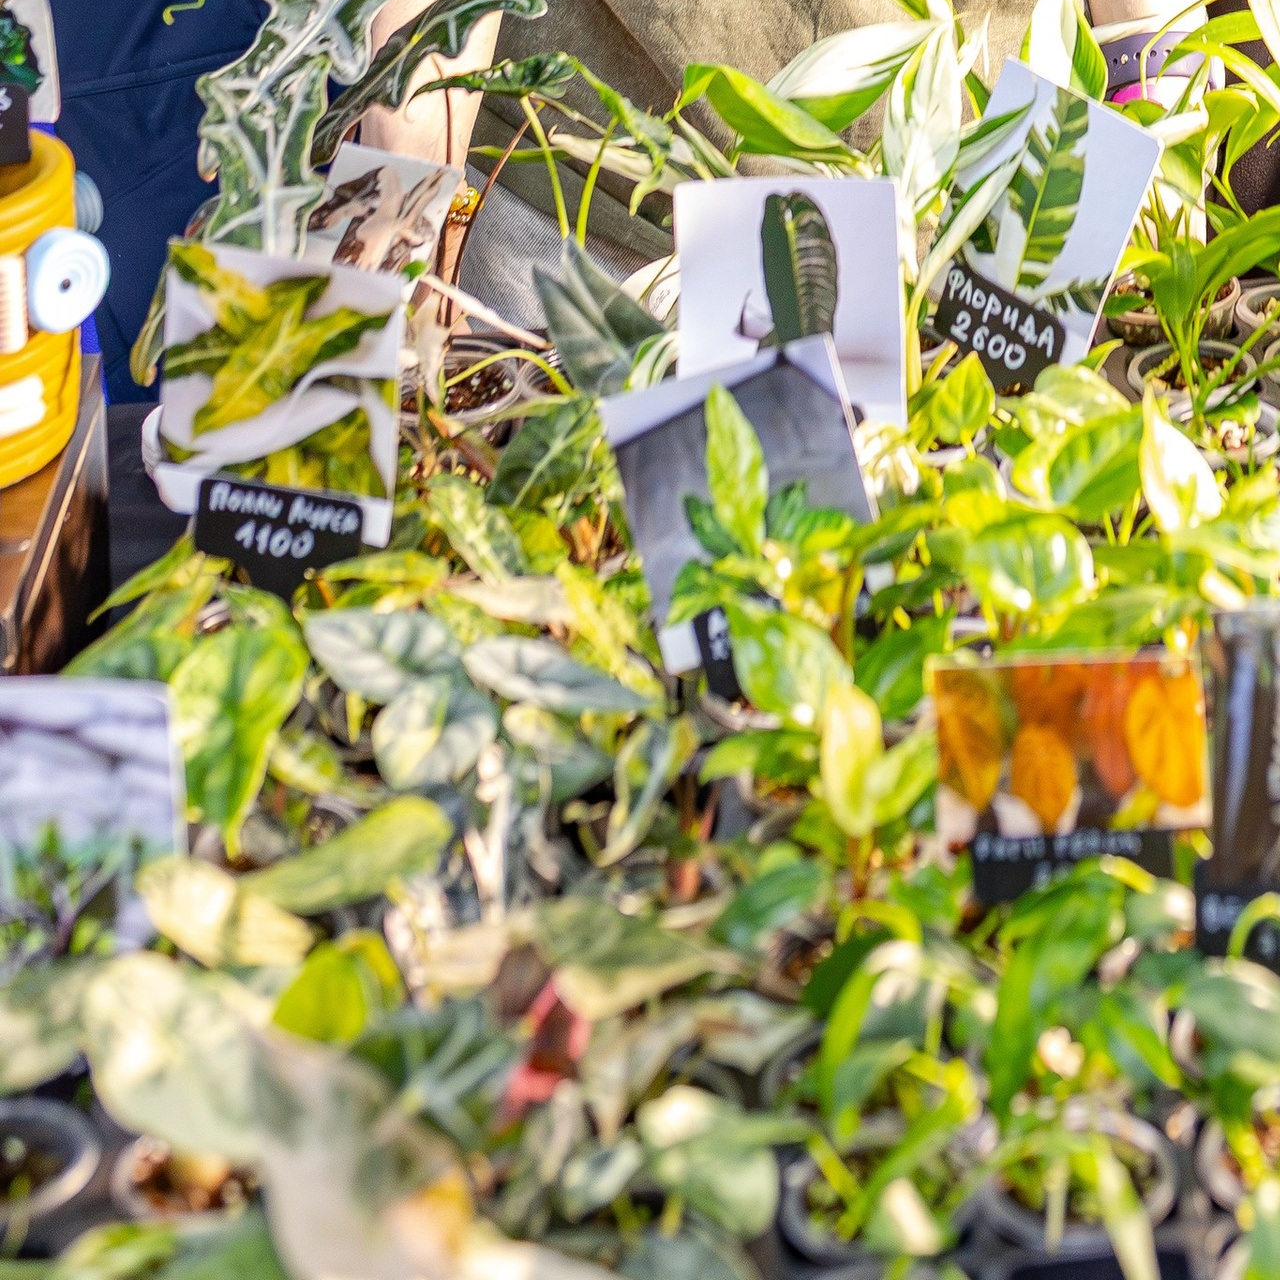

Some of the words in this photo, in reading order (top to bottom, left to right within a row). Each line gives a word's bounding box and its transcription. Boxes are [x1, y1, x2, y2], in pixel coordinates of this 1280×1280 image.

[948, 268, 1055, 359] ФЛОРИДА
[950, 309, 1027, 371] 2600
[234, 519, 315, 559] 1100
